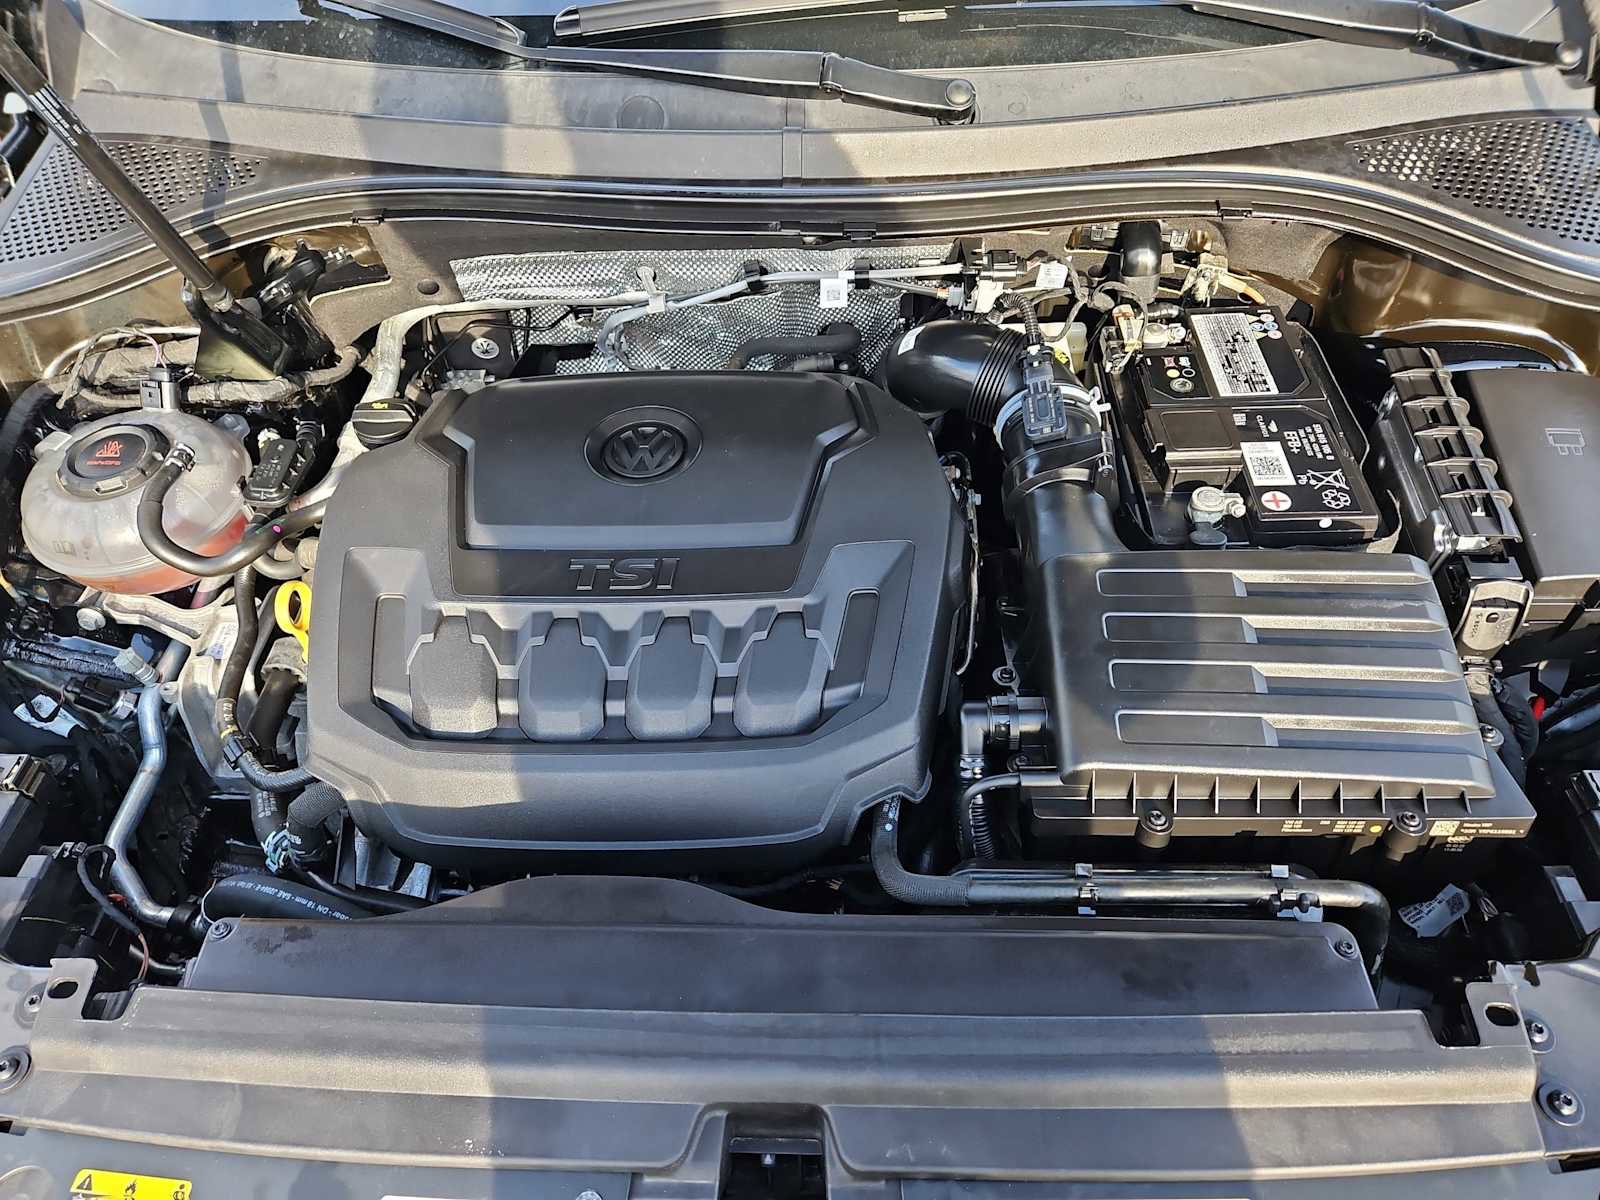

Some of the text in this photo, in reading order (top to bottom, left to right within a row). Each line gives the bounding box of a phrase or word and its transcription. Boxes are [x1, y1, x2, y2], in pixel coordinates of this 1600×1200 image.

[1283, 431, 1302, 454] EFB+
[1296, 474, 1308, 485] Pb
[569, 557, 681, 590] TSI
[278, 890, 292, 901] SAE
[295, 896, 308, 905] mm
[306, 901, 316, 909] 18
[317, 905, 329, 914] DN
